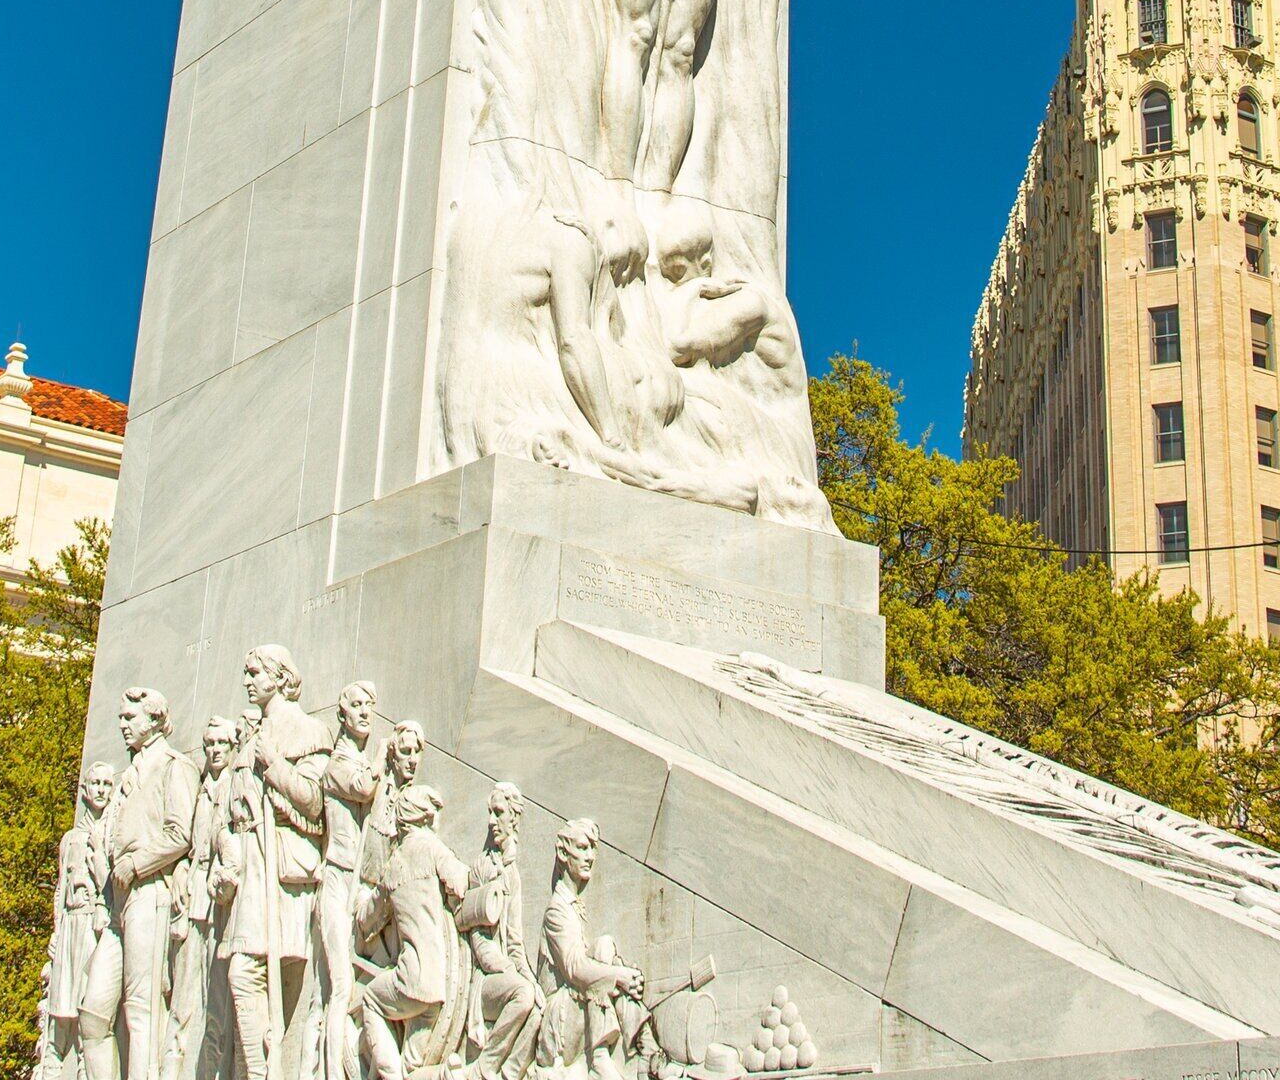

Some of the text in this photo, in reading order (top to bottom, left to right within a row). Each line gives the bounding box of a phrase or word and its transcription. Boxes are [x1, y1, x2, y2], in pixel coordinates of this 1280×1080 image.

[578, 575, 602, 589] ROSE
[607, 581, 626, 595] THE
[657, 607, 681, 622] GAVE
[716, 620, 729, 633] TO
[735, 625, 748, 637] AN
